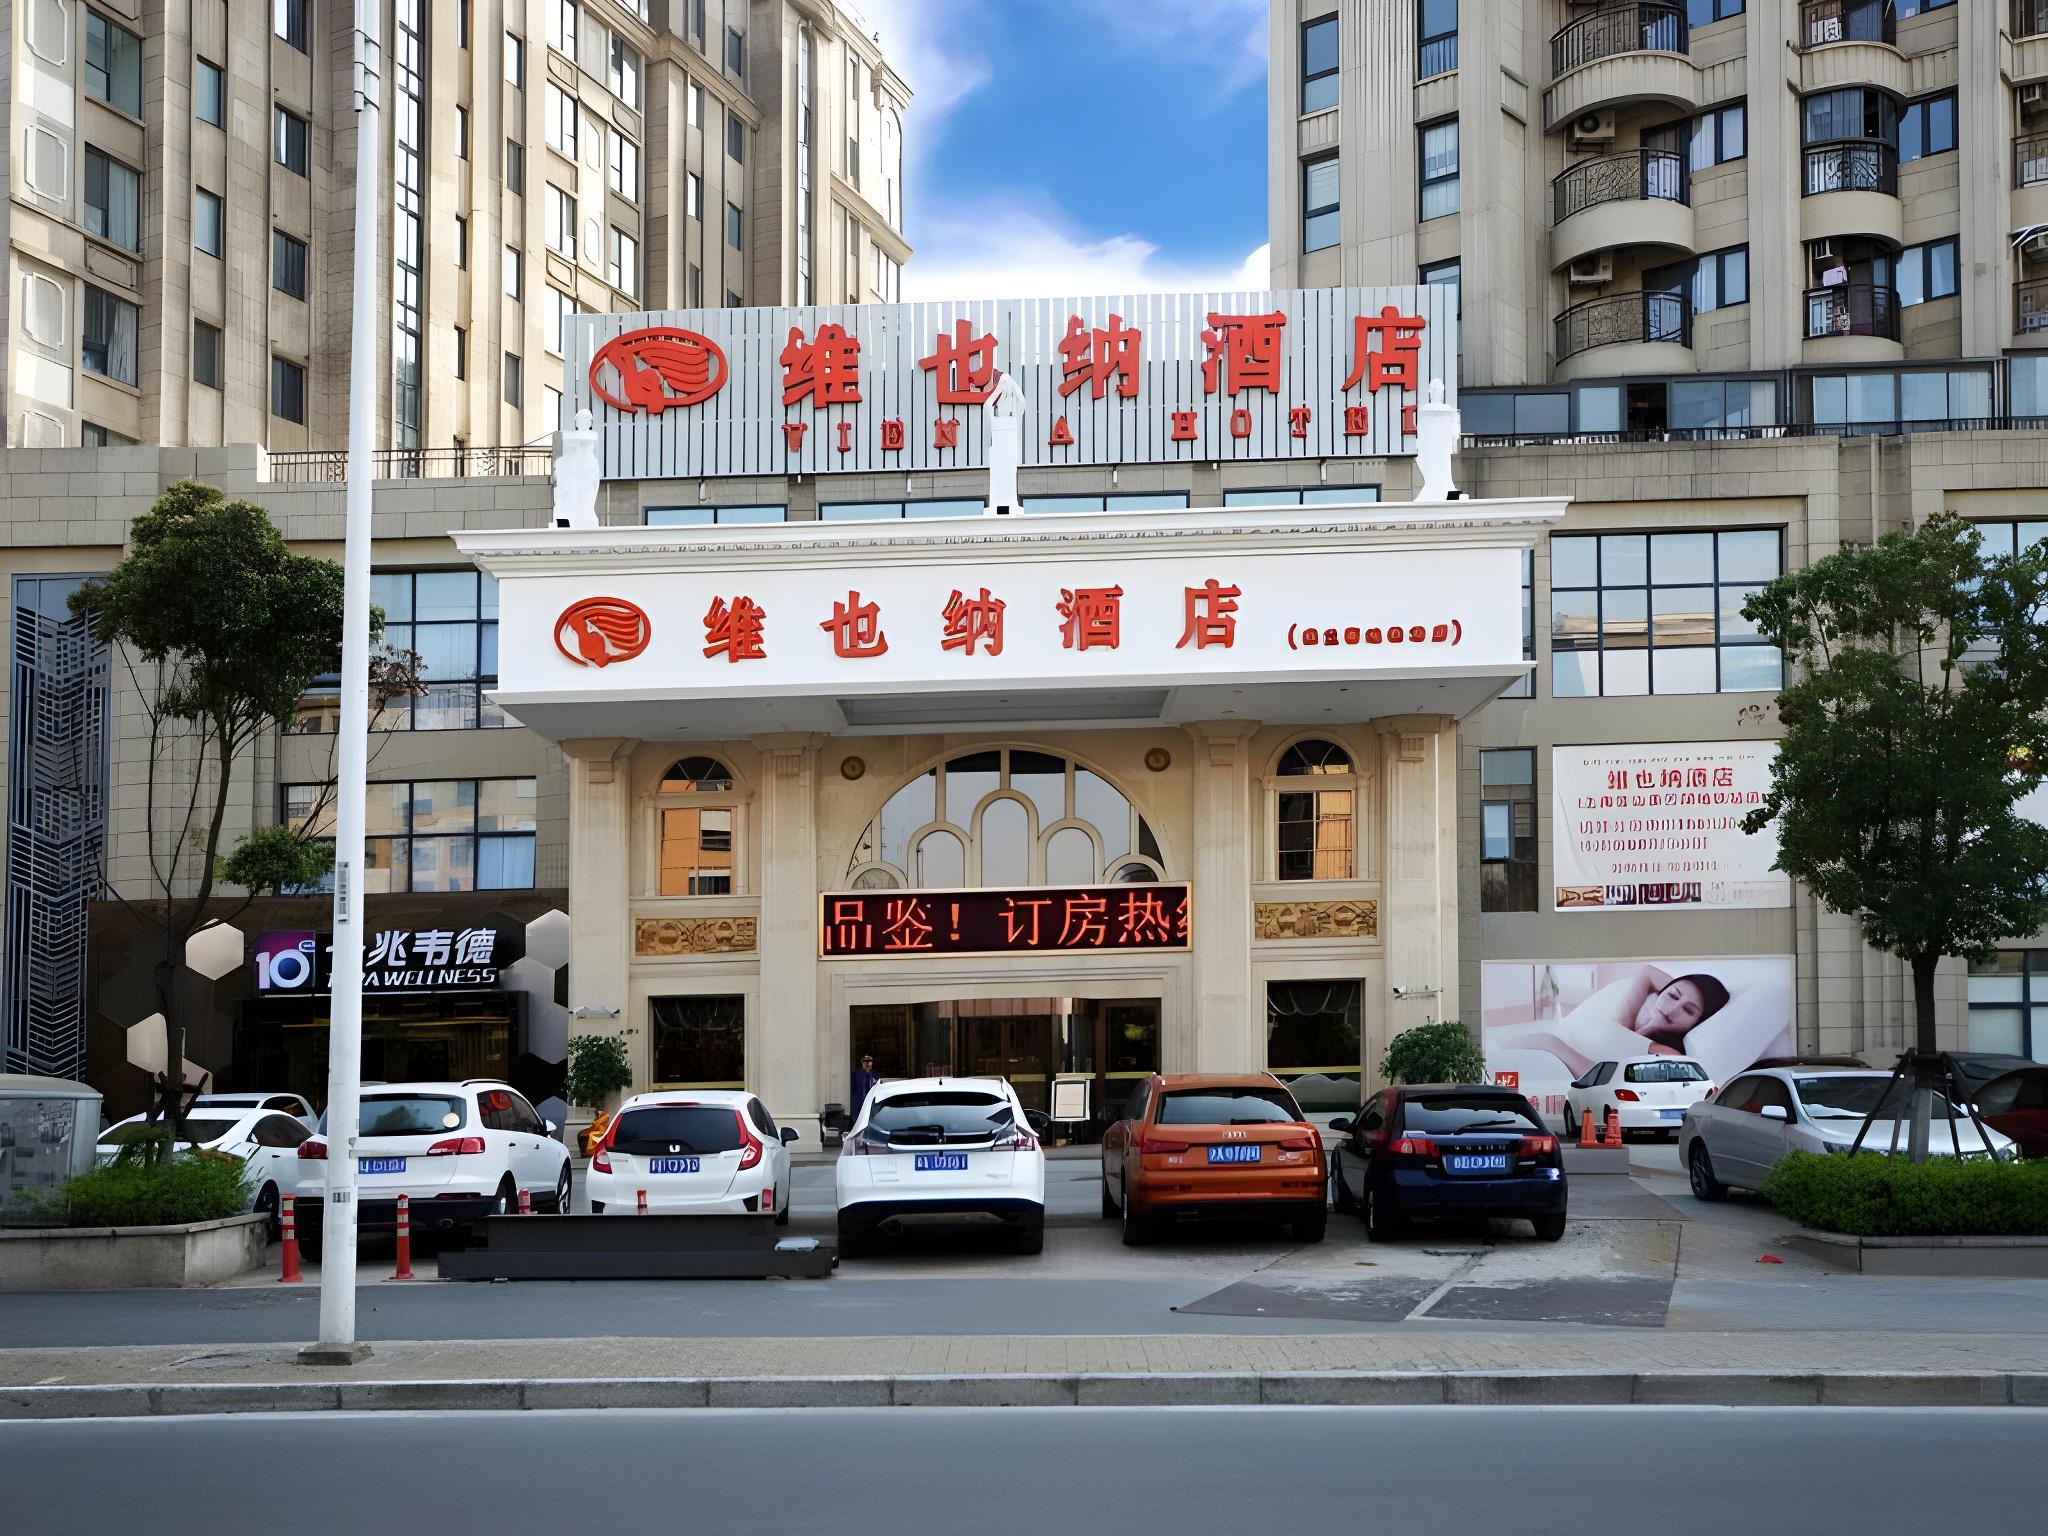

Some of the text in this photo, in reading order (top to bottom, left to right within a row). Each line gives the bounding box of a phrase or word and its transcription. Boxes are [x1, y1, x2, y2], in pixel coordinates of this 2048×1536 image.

[779, 306, 1427, 410] 维也纳酒店
[703, 578, 1242, 663] 维也纳酒店
[326, 927, 497, 967] 兆韦德
